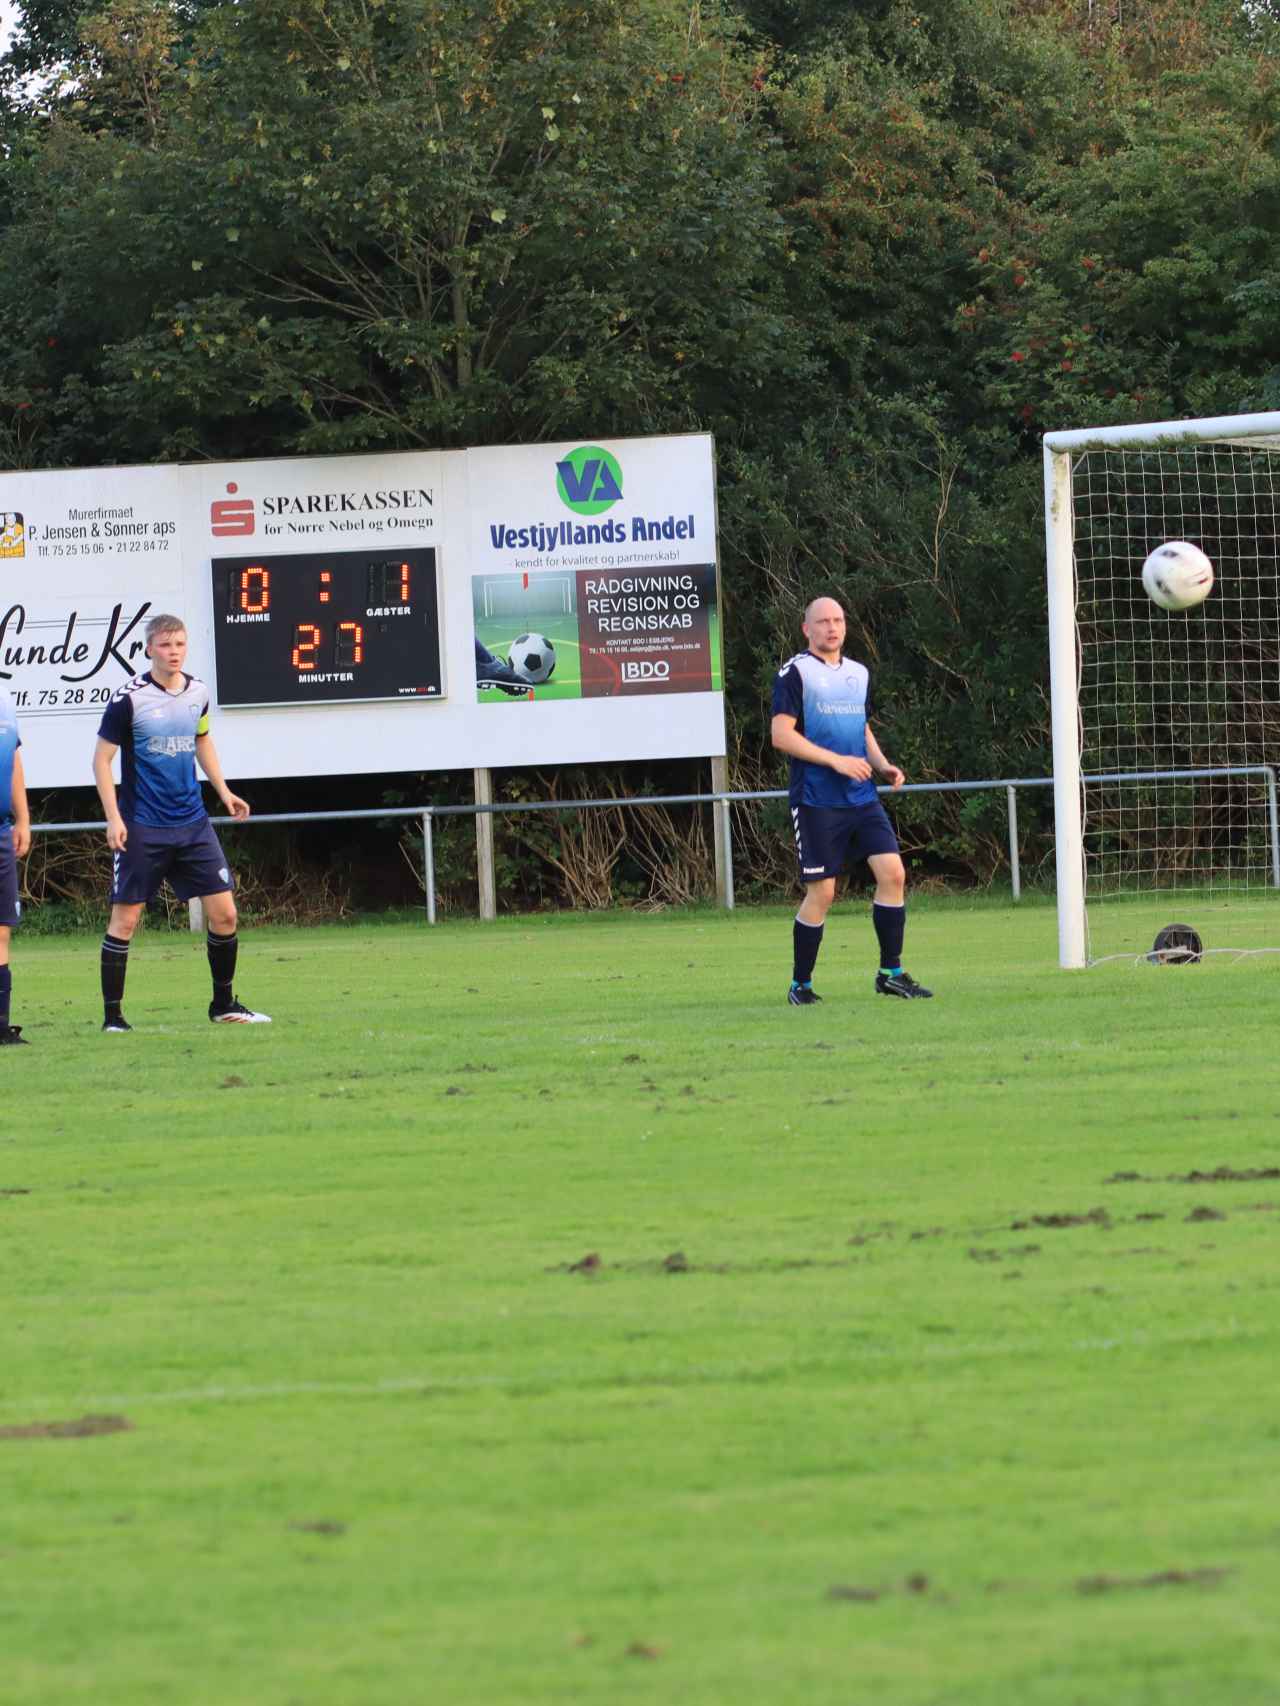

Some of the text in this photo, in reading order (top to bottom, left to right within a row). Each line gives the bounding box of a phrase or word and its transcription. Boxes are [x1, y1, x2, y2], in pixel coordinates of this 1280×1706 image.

[555, 459, 624, 502] VA
[263, 488, 433, 516] SPAREKASSEN
[68, 506, 134, 521] Murerfirmaet
[28, 521, 176, 541] P. Jensen & Sønner aps
[264, 523, 281, 535] for
[329, 519, 364, 532] Nebel
[368, 519, 383, 531] og
[387, 517, 433, 529] Omegn
[490, 514, 695, 552] Vestjyllands Andel
[53, 545, 64, 556] 75
[66, 544, 77, 556] 25
[81, 543, 90, 554] 15
[93, 543, 104, 554] 06
[117, 541, 127, 553] 21
[130, 541, 141, 552] 22
[143, 540, 155, 551] 84
[158, 539, 169, 551] 72
[514, 558, 543, 569] kendt
[545, 556, 559, 567] for
[562, 555, 598, 567] kvalitet
[602, 556, 614, 567] og
[240, 566, 269, 612] 0
[400, 563, 410, 601] 1
[584, 575, 698, 595] RÅDGIVNING,
[366, 606, 411, 618] GÆSTER
[587, 593, 700, 614] REVISION OG
[226, 613, 270, 624] HJEMME
[598, 613, 693, 633] REGNSKAB
[292, 621, 363, 669] 27
[298, 672, 354, 684] MINUTTER
[627, 660, 670, 678] BDO
[39, 690, 58, 705] 75
[64, 688, 85, 704] 28
[90, 687, 111, 703] 20
